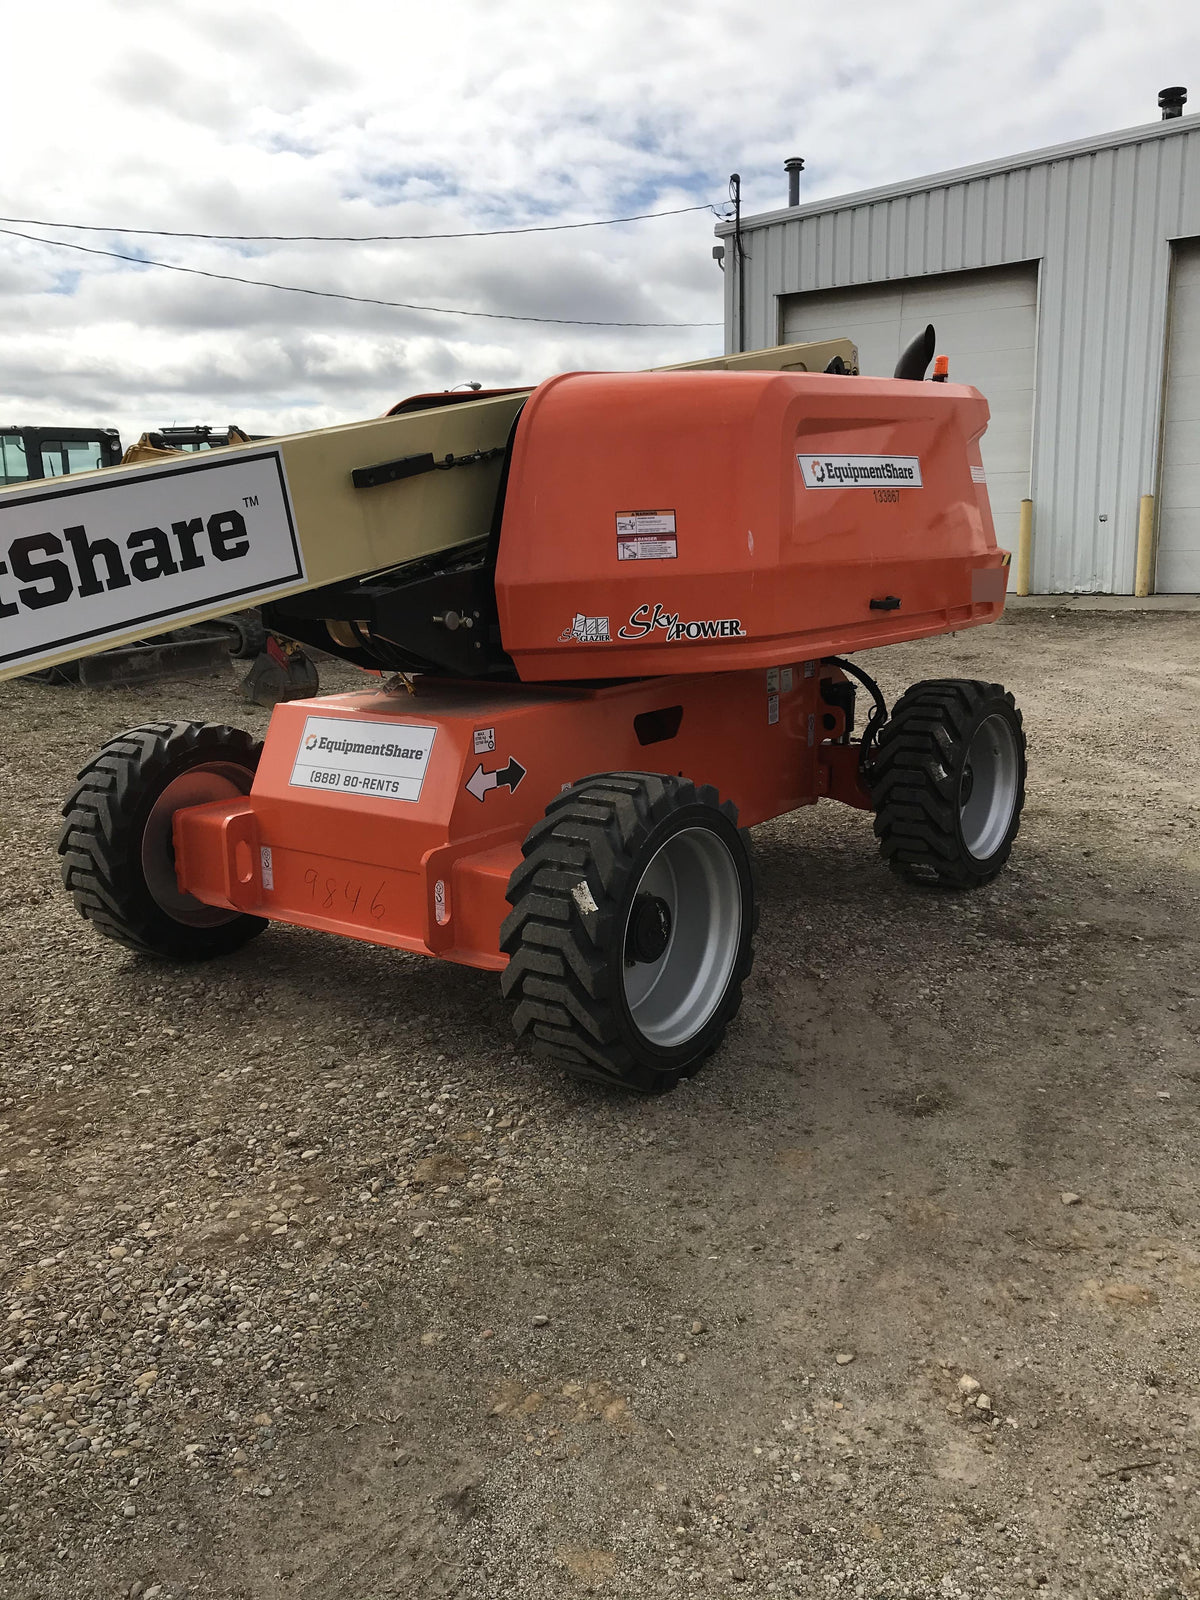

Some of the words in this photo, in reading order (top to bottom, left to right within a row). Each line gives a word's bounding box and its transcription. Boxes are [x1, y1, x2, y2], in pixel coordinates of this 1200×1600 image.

[825, 463, 914, 482] EquipmentShare
[675, 620, 741, 639] POWER
[318, 737, 423, 760] EquipmentShare
[310, 770, 341, 786] (888)
[343, 775, 400, 793] 80-RENTS
[304, 868, 386, 920] 9846
